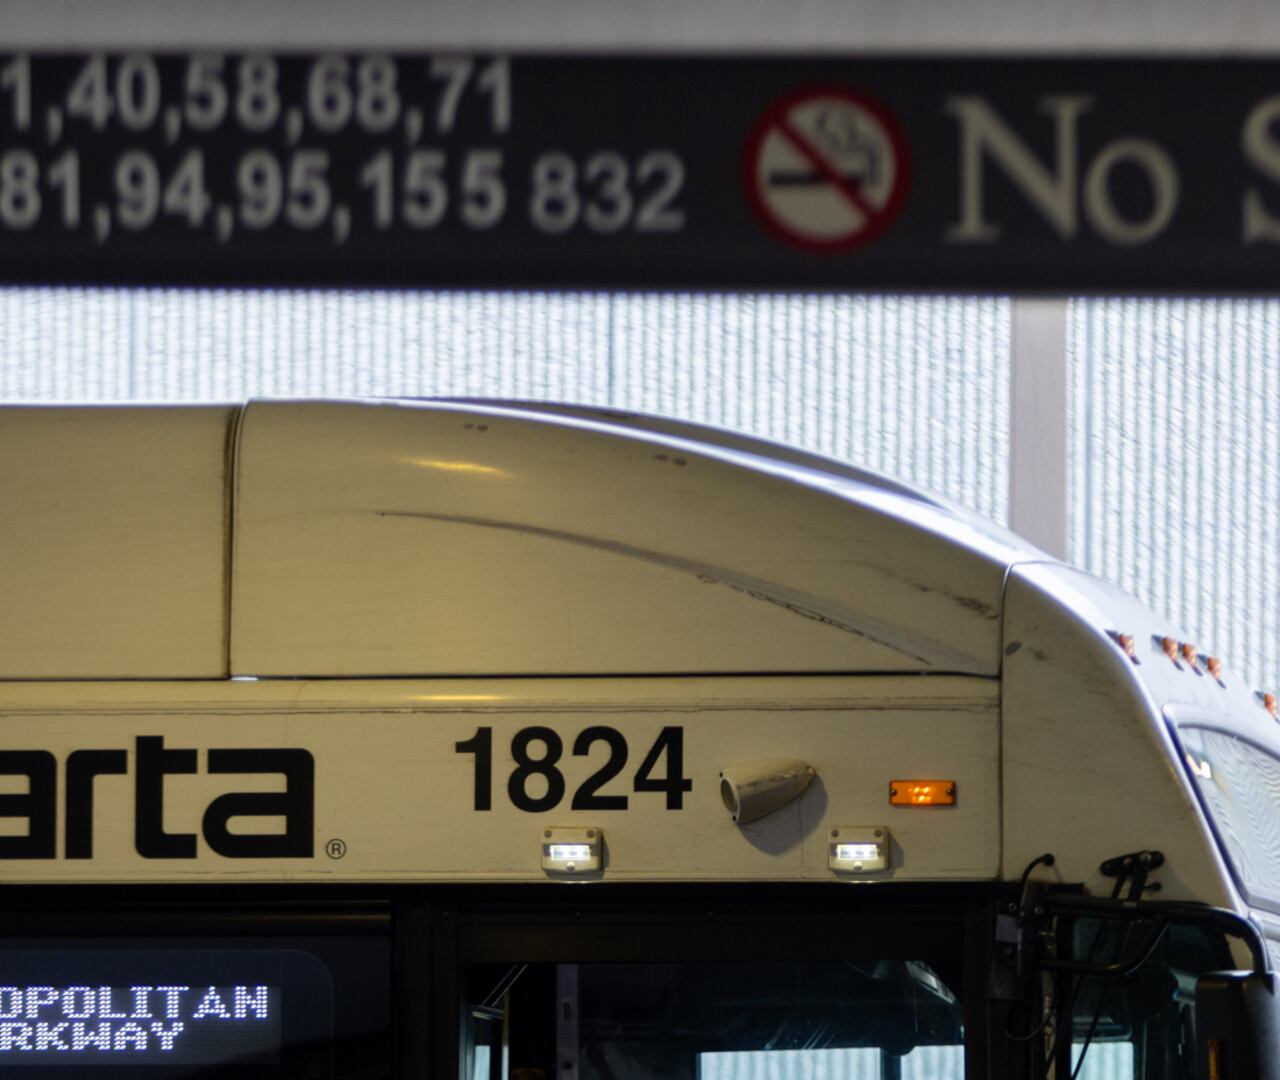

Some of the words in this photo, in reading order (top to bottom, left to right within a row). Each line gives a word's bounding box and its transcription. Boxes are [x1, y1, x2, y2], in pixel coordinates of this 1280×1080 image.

[529, 151, 686, 233] 832
[946, 96, 1179, 246] No
[455, 725, 692, 813] 1824
